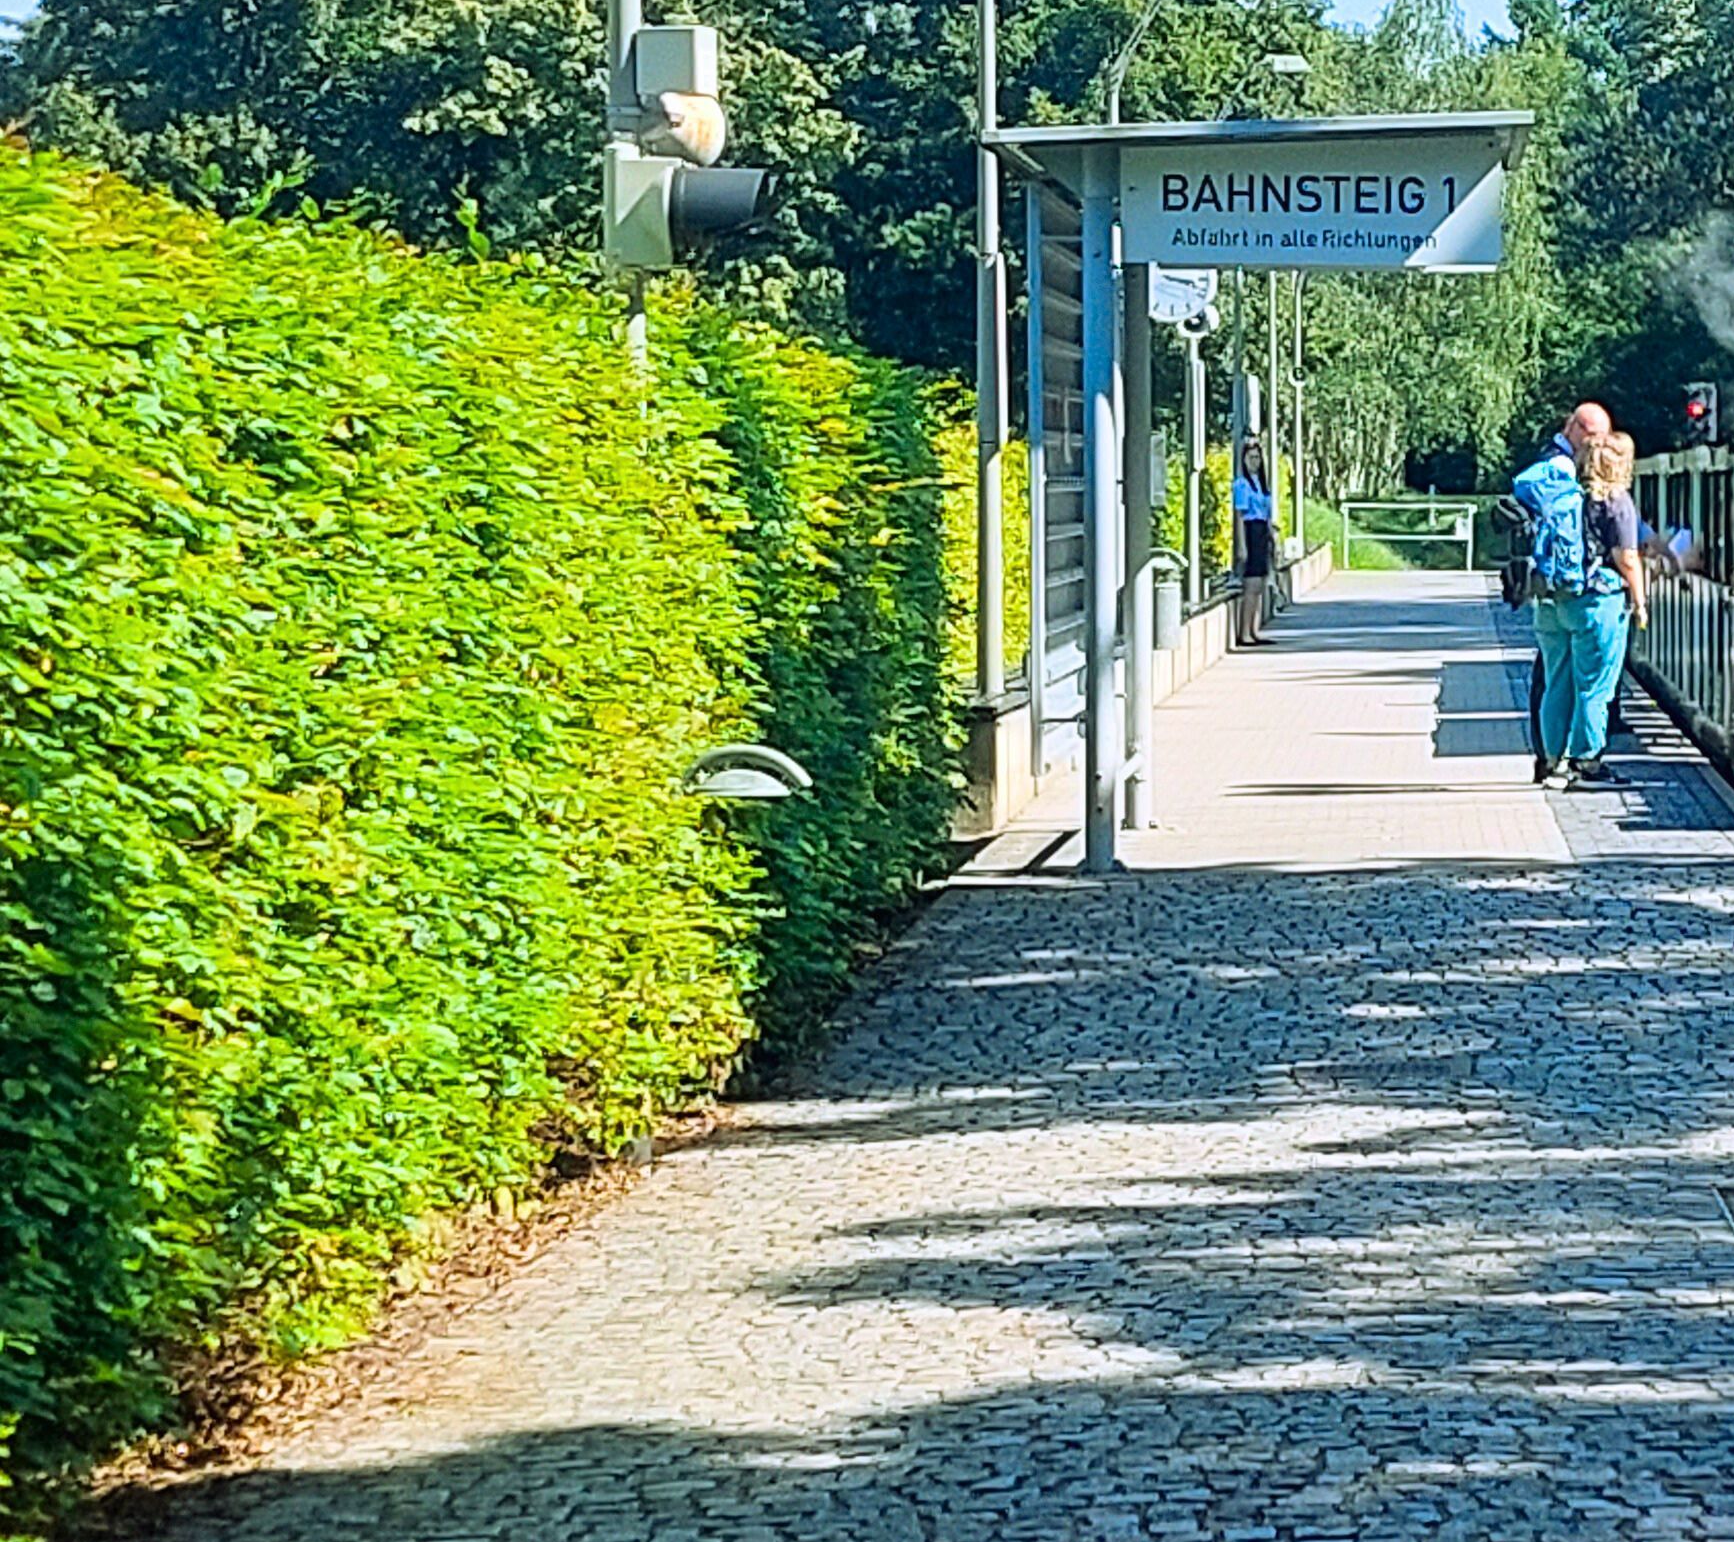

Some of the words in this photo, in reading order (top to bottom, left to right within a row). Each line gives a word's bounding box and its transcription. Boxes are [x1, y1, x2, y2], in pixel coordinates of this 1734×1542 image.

[1161, 172, 1426, 214] BAHNSTEIG
[1442, 175, 1456, 216] 1
[1171, 227, 1249, 247] Abfahrt
[1254, 228, 1273, 247] in
[1279, 228, 1318, 248] alle
[1322, 229, 1437, 253] Richtungen
